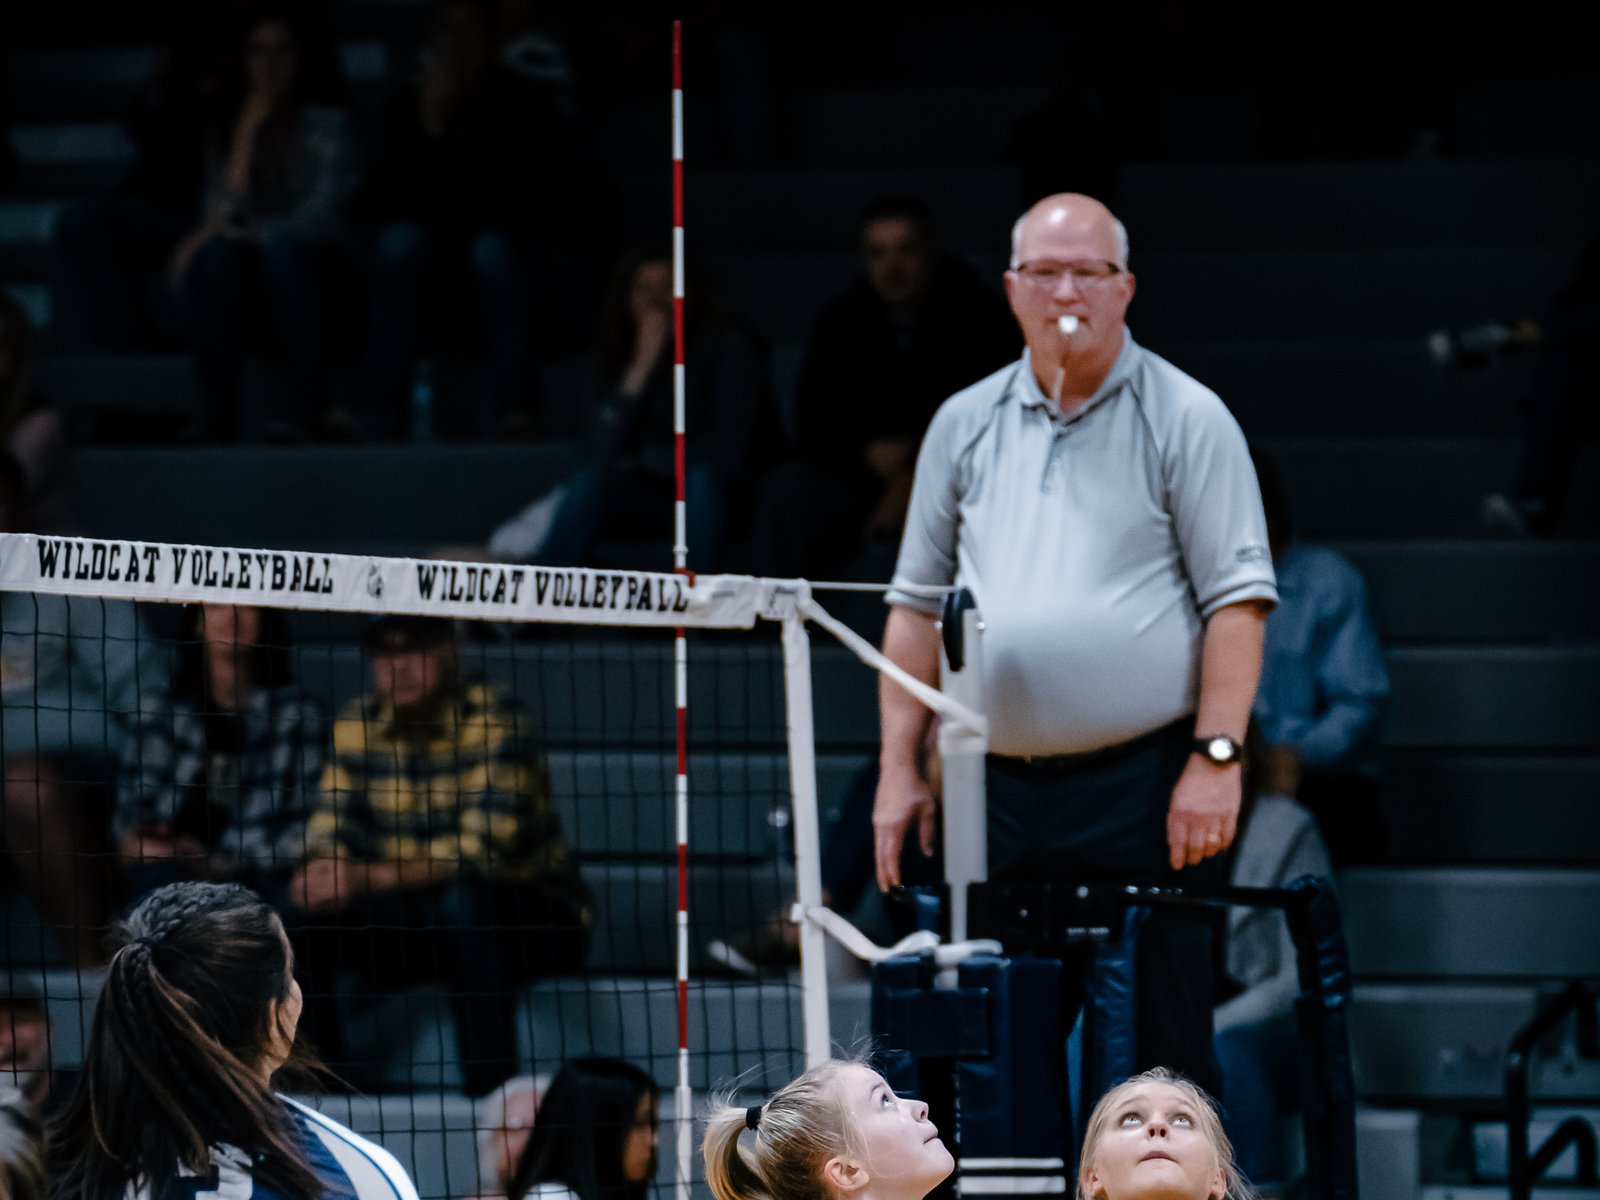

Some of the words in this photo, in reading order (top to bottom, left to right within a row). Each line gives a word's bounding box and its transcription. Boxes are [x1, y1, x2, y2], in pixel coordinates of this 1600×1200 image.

[37, 539, 161, 583] WILDCAT
[171, 547, 334, 594] VOLLEYBALL
[417, 563, 525, 604] WILDCAT
